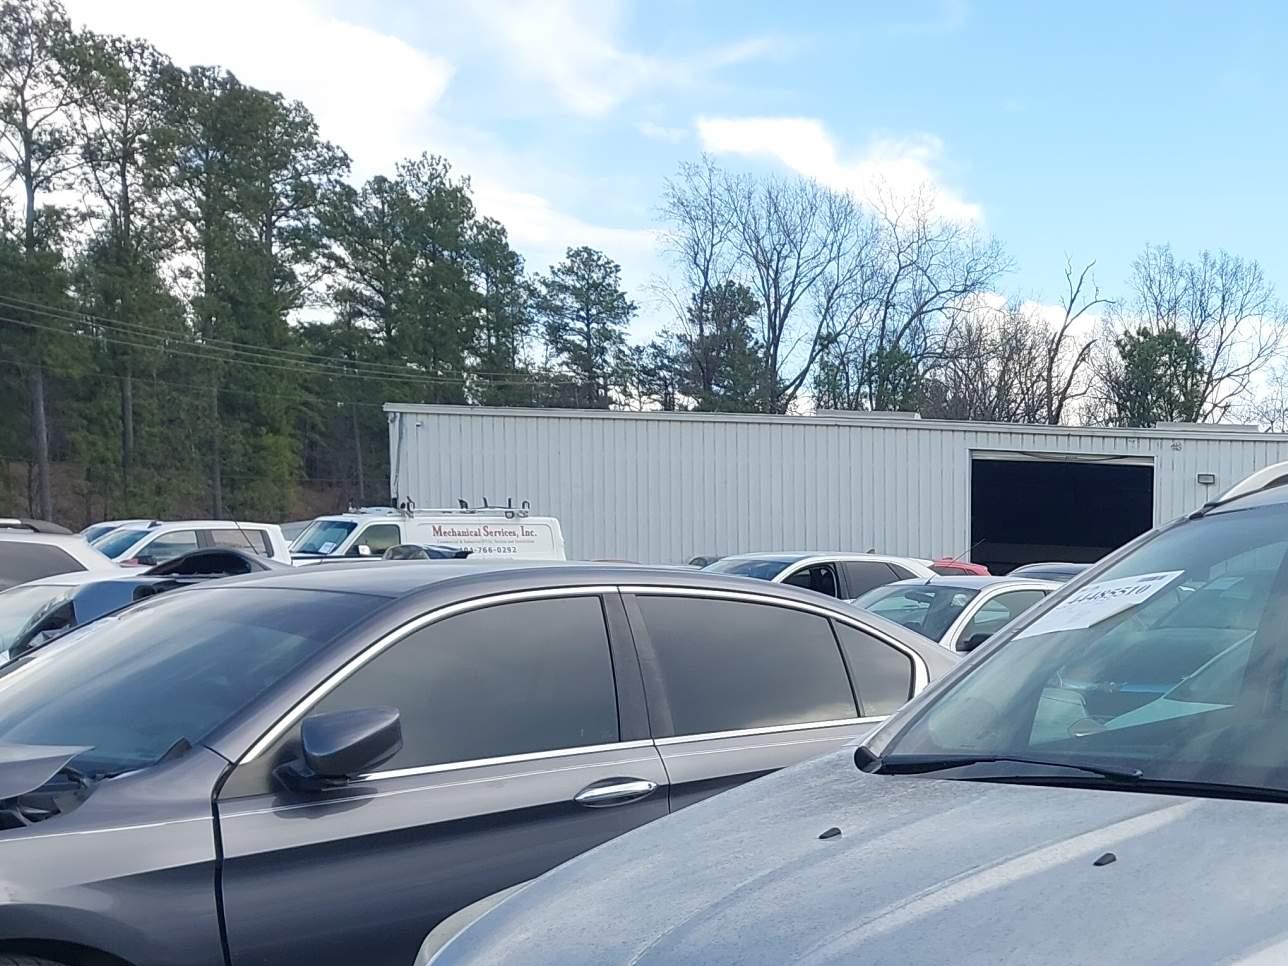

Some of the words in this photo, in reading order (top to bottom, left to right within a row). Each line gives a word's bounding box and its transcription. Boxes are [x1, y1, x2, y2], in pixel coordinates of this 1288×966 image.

[432, 525, 481, 537] Mechanical
[482, 525, 519, 538] Services,
[520, 525, 537, 537] Inc.
